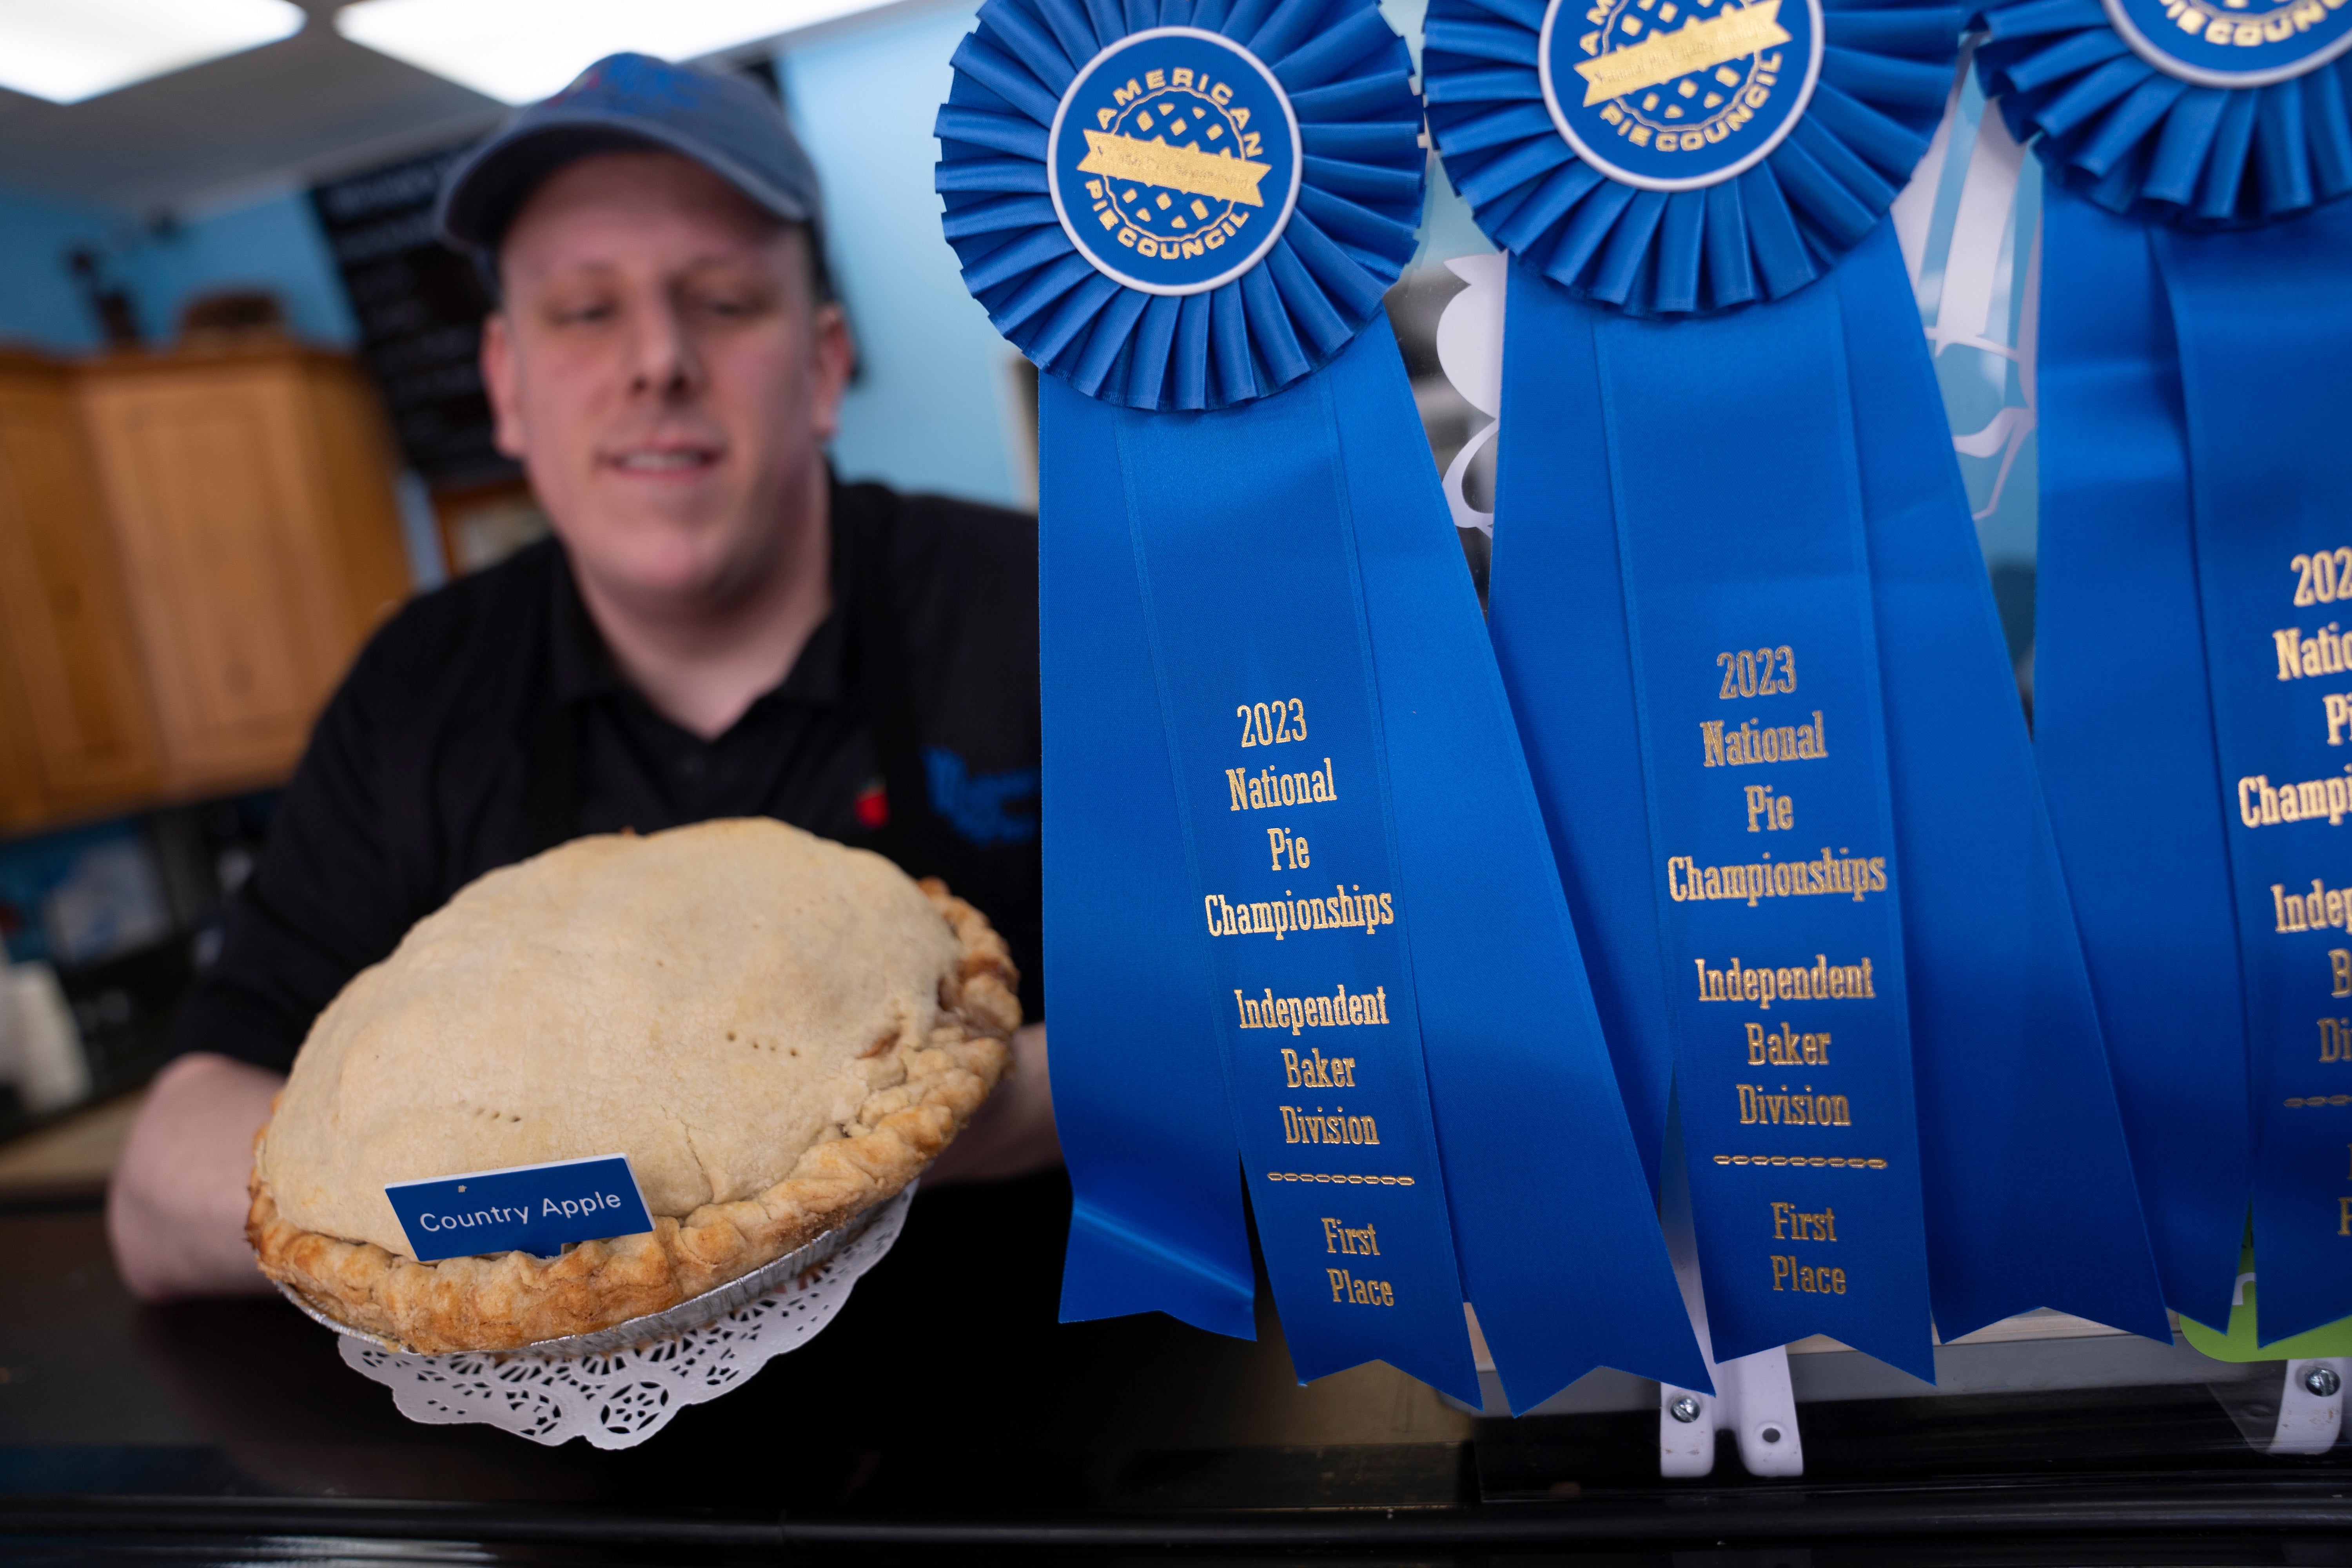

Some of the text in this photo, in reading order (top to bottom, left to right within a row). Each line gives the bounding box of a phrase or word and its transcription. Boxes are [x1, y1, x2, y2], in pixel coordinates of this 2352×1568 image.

[1097, 67, 1264, 158] AMERICAN
[1599, 51, 1783, 152] PIE COUNCIL
[1085, 179, 1250, 260] PIE COUNCIL
[1717, 645, 1797, 699] 2023
[1237, 698, 1307, 748] 2023
[1700, 711, 1828, 767] National
[1225, 758, 1337, 811] National
[1744, 785, 1794, 832] Pie
[1267, 828, 1310, 871] Pie
[1668, 848, 1886, 907] Championships
[1205, 885, 1394, 940] Championships
[1695, 954, 1874, 1009] Independent
[1234, 984, 1389, 1035] Independent
[1281, 1048, 1355, 1087] Baker
[1745, 1022, 1831, 1065] Baker
[1279, 1106, 1380, 1145] Division
[1736, 1085, 1851, 1126] Division
[420, 1192, 621, 1231] Country Apple
[1770, 1202, 1837, 1242] First
[1321, 1218, 1380, 1255] First
[1326, 1269, 1394, 1306] Place
[1770, 1256, 1846, 1294] Place
